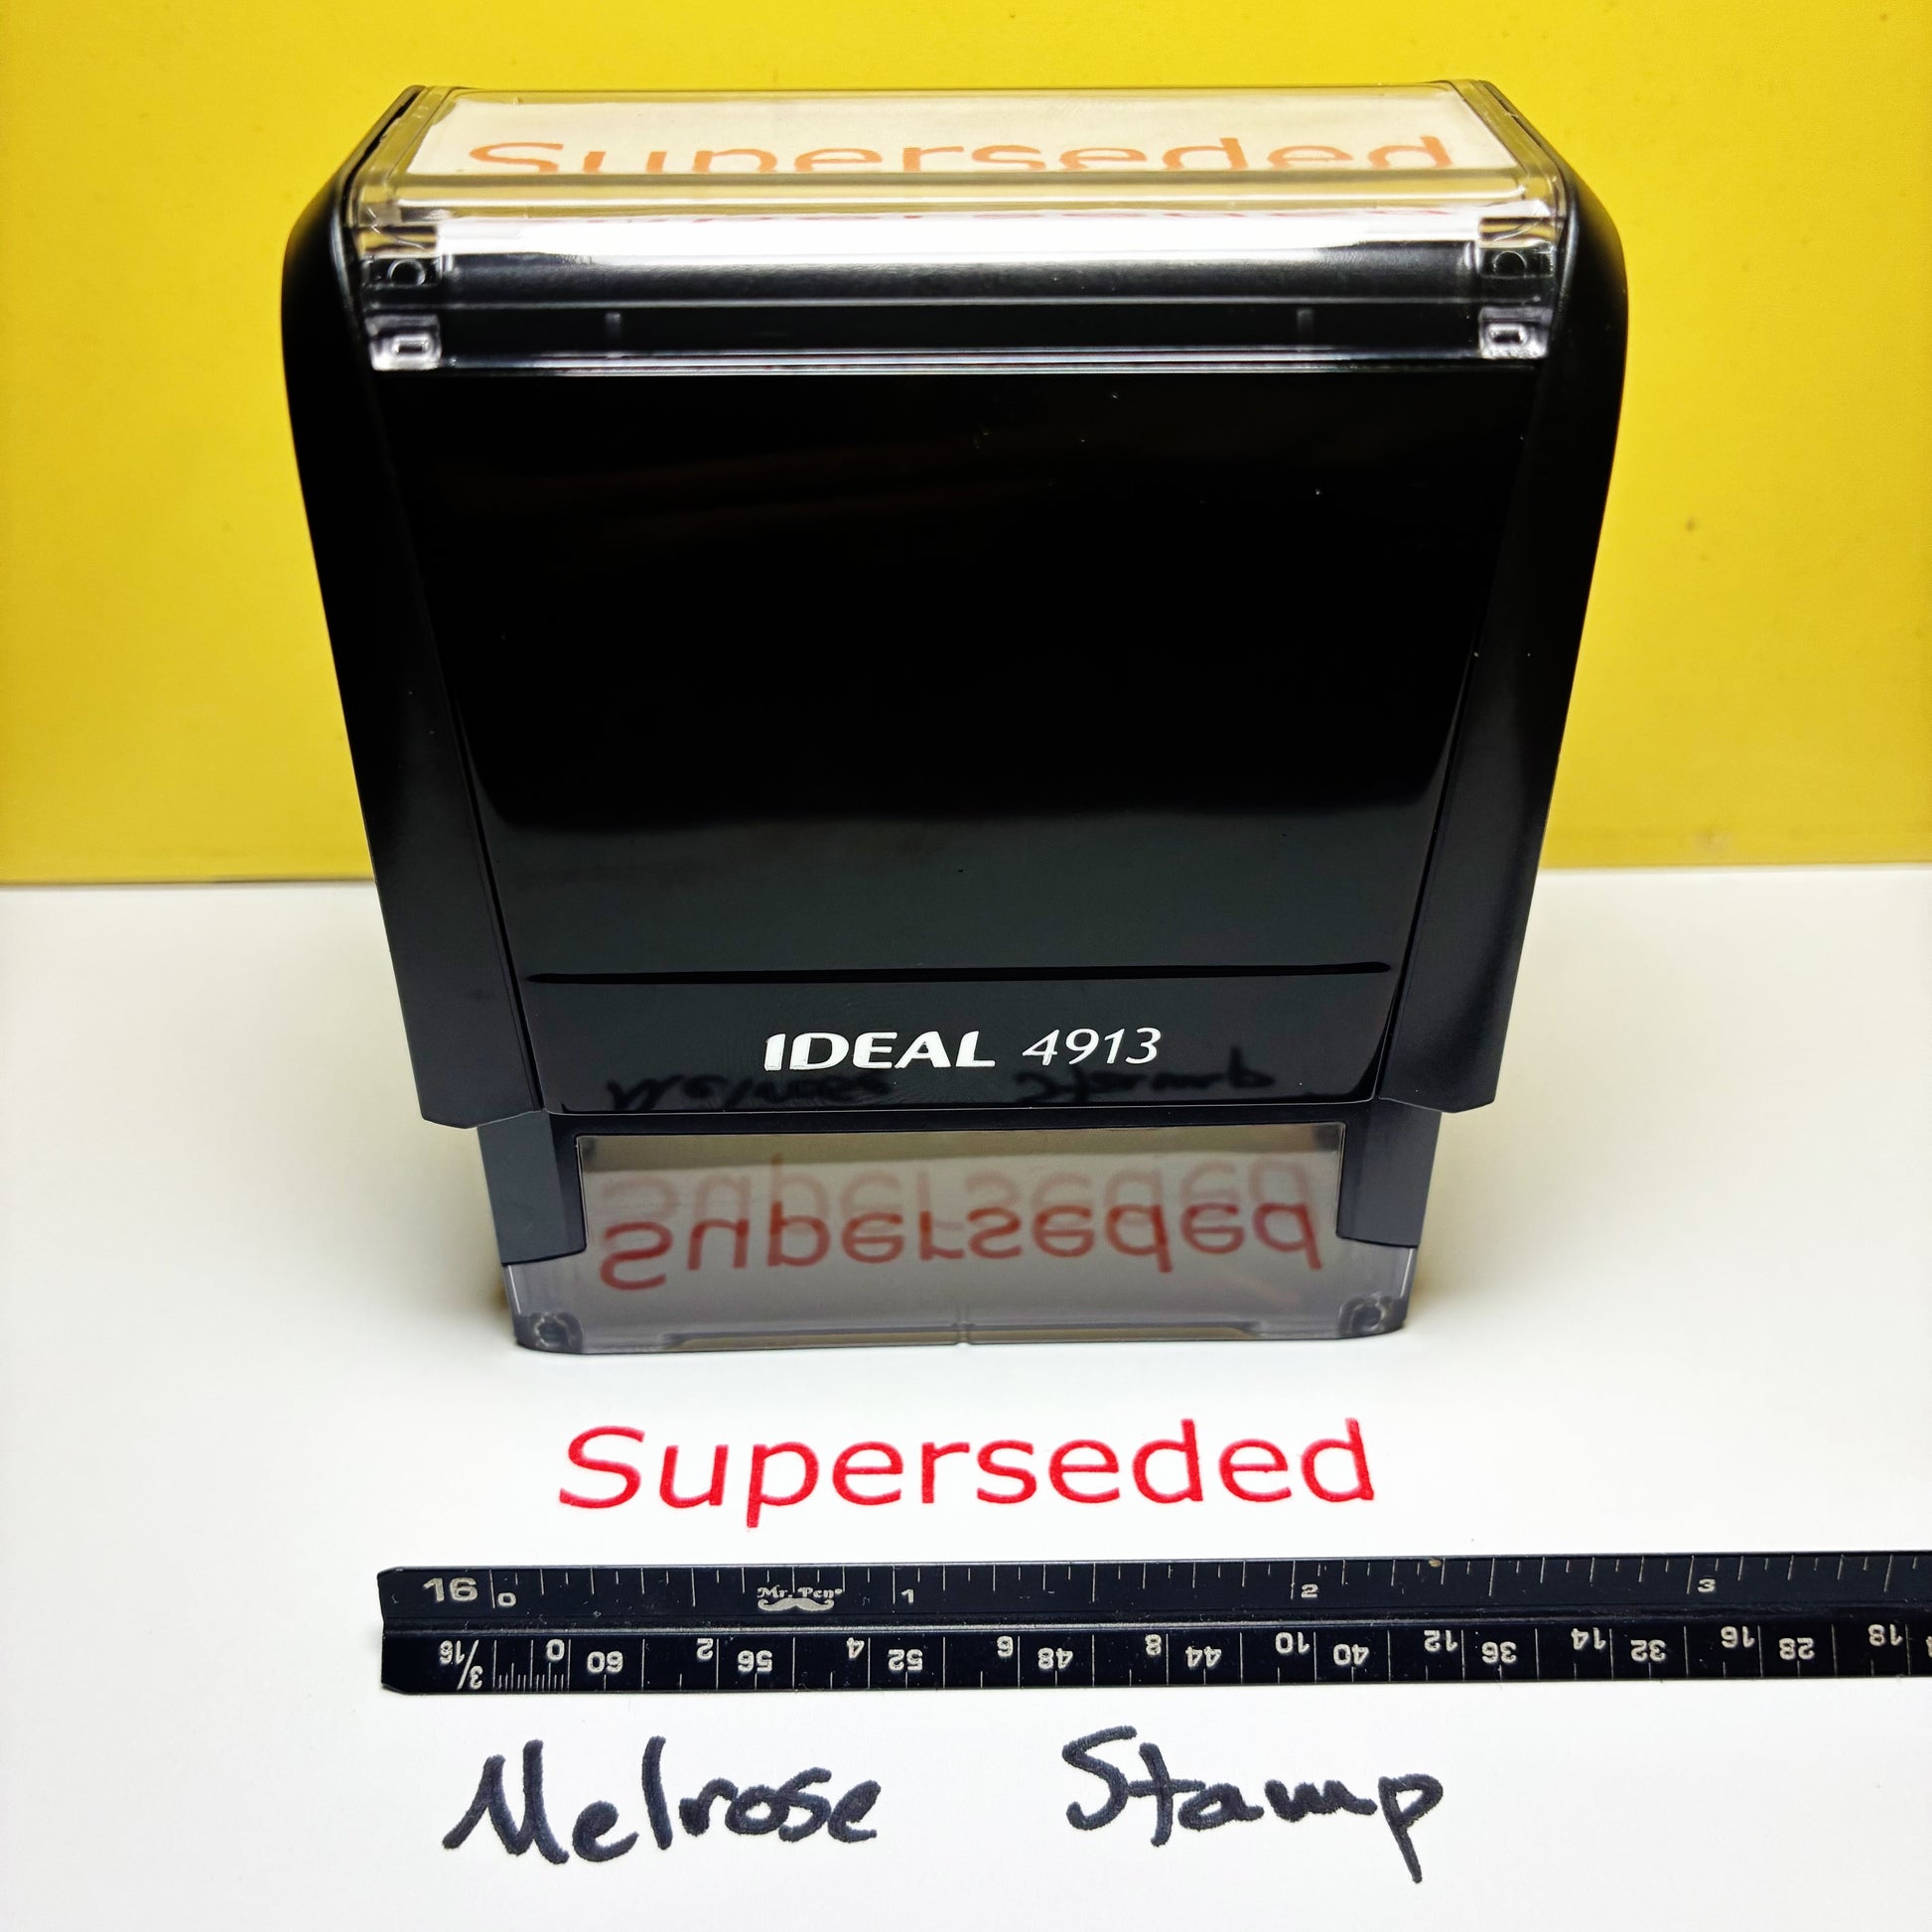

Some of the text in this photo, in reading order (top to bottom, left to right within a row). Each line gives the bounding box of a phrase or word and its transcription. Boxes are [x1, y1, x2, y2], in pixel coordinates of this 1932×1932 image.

[763, 1027, 1162, 1071] IDEAL 4913
[559, 1419, 1375, 1529] Superseded
[423, 1578, 479, 1602] 16
[497, 1578, 1717, 1607] 0 1 2 3
[757, 1584, 793, 1598] Mr.
[546, 1623, 1903, 1662] 18 16 14 12 10 8 6 4 2 0
[586, 1637, 1815, 1674] 28 32 36 40 44 48 52 56 60
[442, 1725, 1444, 1884] Melrose Stamp
